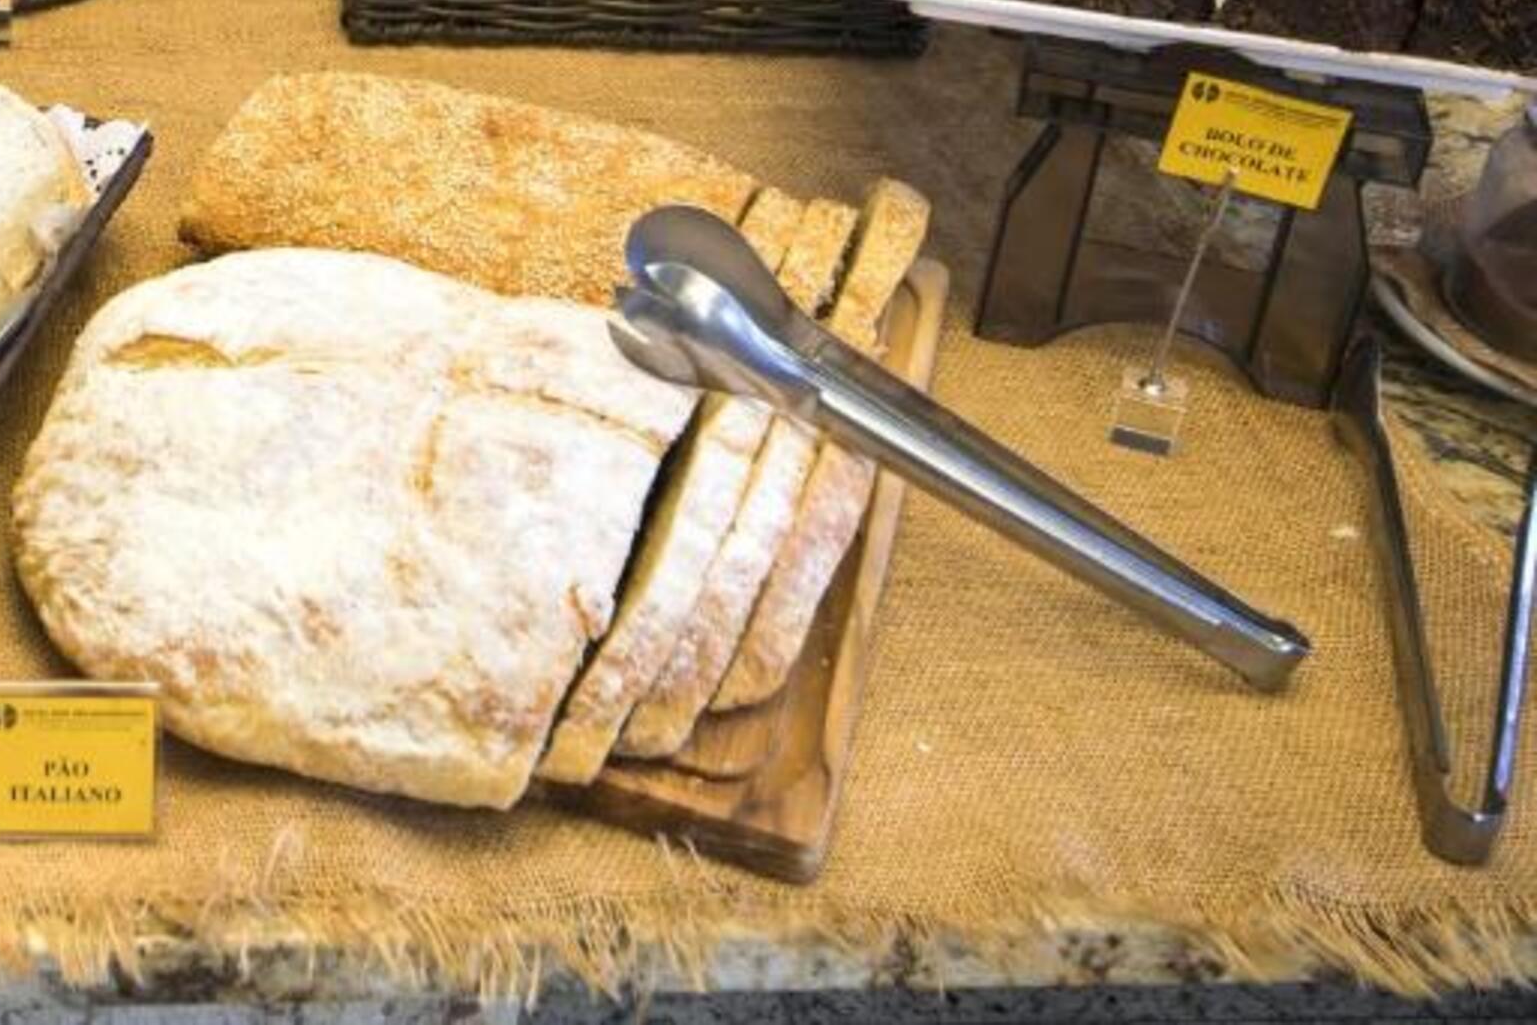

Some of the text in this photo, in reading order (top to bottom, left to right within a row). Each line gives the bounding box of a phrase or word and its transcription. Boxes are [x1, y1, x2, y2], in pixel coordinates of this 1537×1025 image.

[1206, 127, 1298, 162] BOLO DE
[1178, 140, 1311, 182] CHOCOLATE
[43, 754, 91, 778] PÃO
[10, 785, 123, 803] ITALIANO
